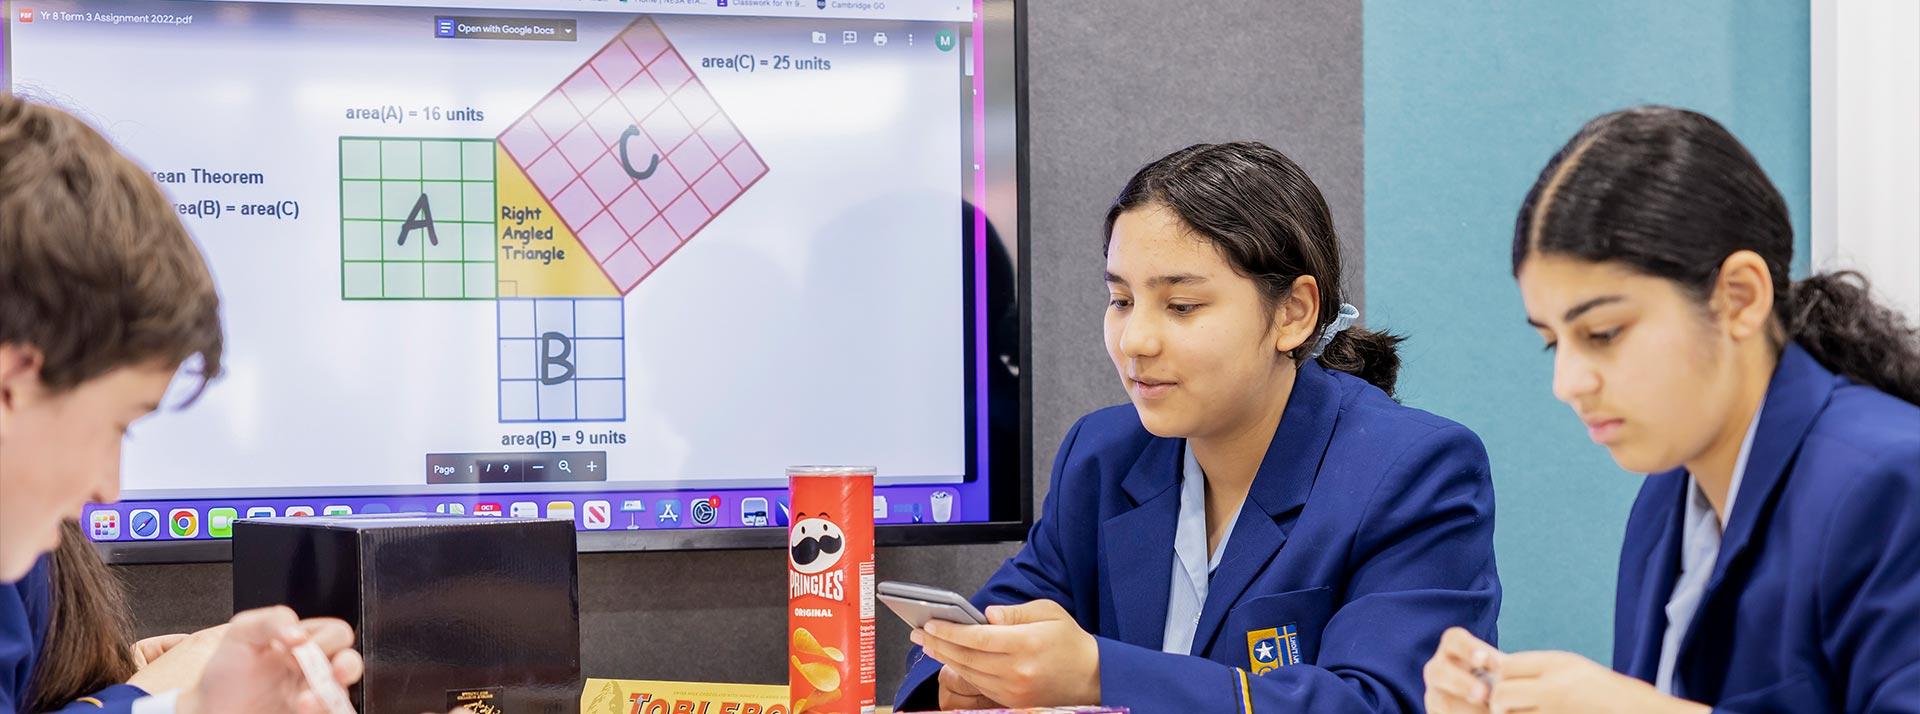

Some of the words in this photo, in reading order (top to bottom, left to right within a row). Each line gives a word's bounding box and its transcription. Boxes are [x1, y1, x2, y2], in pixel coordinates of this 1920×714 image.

[831, 1, 871, 10] Cambridge
[40, 11, 51, 20] Yr
[52, 12, 59, 20] 8
[60, 12, 84, 21] Term
[86, 13, 92, 21] 3
[94, 13, 149, 24] Assignment
[150, 15, 193, 25] 2022.pdf
[458, 23, 481, 34] Open
[482, 24, 500, 33] with
[502, 25, 532, 36] Google
[534, 25, 555, 34] Docs
[939, 36, 950, 46] M
[702, 54, 755, 72] area(C)
[773, 55, 790, 70] 25
[795, 56, 831, 70] units
[346, 105, 403, 124] area(A)
[423, 106, 441, 120] 16
[446, 107, 484, 121] units
[619, 124, 659, 180] C
[151, 171, 186, 183] rean
[191, 168, 264, 184] Theorem
[240, 200, 299, 219] area(C)
[502, 206, 542, 225] Right
[397, 193, 438, 246] A
[502, 226, 553, 245] Angled
[502, 246, 565, 265] Triangle
[541, 331, 576, 385] B
[501, 430, 557, 449] area(B)
[575, 431, 584, 444] 9
[589, 430, 626, 444] units
[434, 465, 455, 475] Page
[468, 465, 473, 473] 1
[503, 464, 509, 473] 9
[790, 569, 844, 601] PRINGLES
[794, 607, 833, 617] ORIGINAL
[629, 693, 790, 714] TOBLERO
